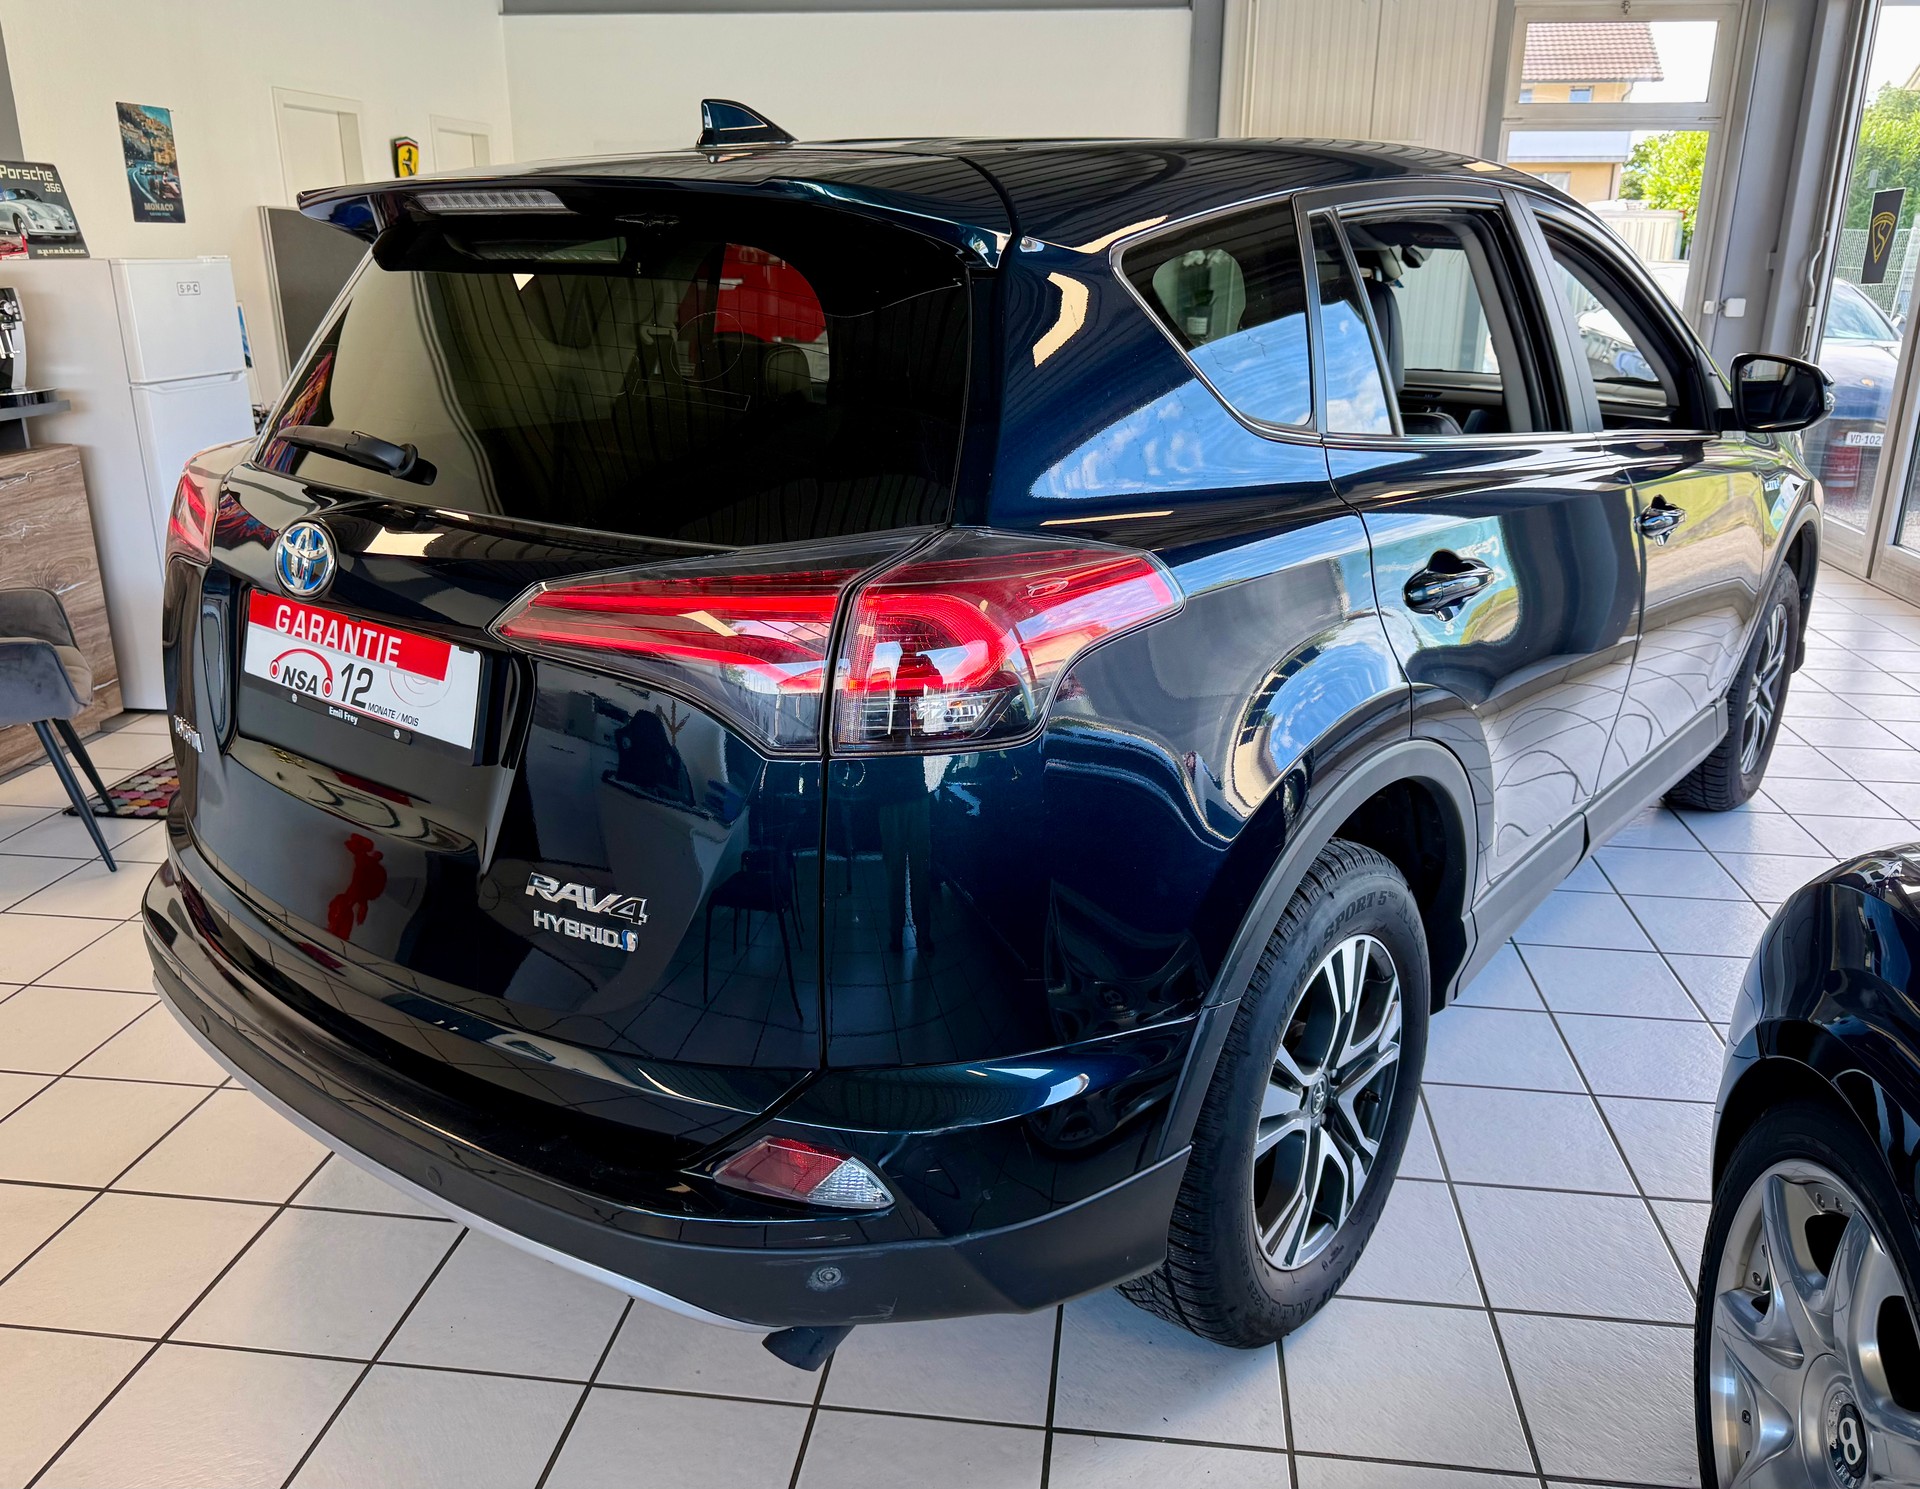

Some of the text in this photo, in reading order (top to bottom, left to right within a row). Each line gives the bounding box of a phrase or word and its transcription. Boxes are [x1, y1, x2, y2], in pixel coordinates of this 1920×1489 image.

[0, 164, 54, 182] Porsche
[44, 182, 62, 193] 356
[143, 202, 175, 212] MONACO
[275, 604, 402, 668] GARANTIE
[281, 665, 318, 695] NSA
[340, 663, 374, 709] 12
[367, 702, 397, 720] MONATE
[400, 711, 420, 727] MOIS
[328, 706, 359, 726] Emil Frey
[525, 872, 651, 926] RAV4
[533, 909, 619, 948] HYBRID
[1323, 891, 1376, 947] SPORT
[1378, 890, 1388, 906] 5
